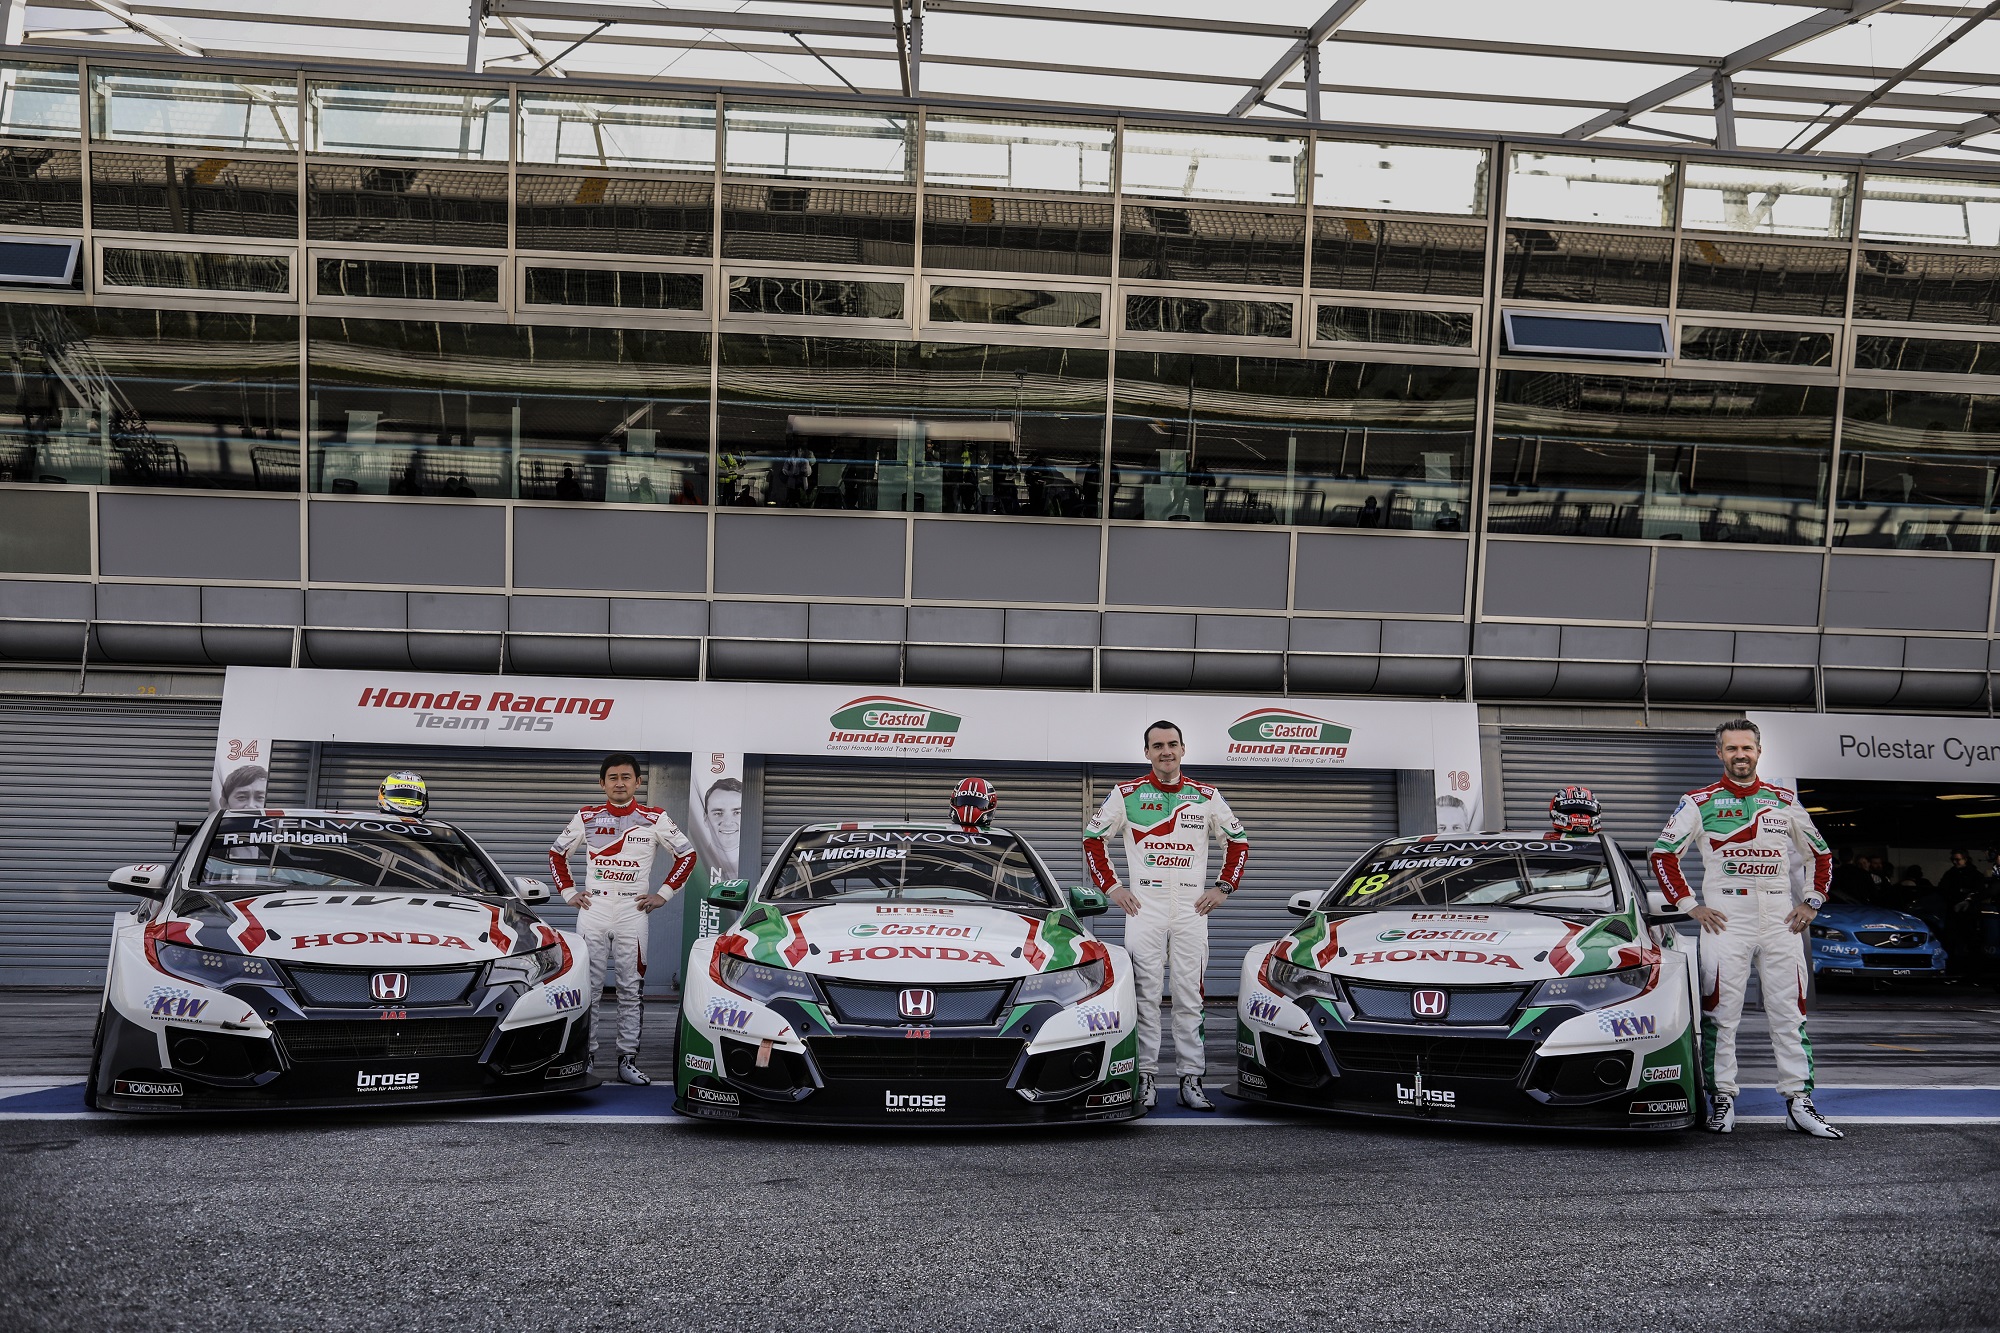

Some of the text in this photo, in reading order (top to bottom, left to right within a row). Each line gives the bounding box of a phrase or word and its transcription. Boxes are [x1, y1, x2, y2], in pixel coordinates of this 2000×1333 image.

[358, 688, 614, 720] Honda Racing
[413, 712, 553, 731] Team JAS
[879, 712, 926, 726] Castrol
[1275, 724, 1318, 738] Castrol
[829, 731, 956, 748] Honda Racing
[227, 739, 259, 761] 34
[1228, 743, 1348, 759] Honda Racing
[1839, 735, 1935, 760] Polestar
[711, 753, 726, 774] 5
[394, 784, 422, 792] HONDA
[1447, 771, 1471, 791] 18
[955, 790, 989, 801] HONDA
[1140, 803, 1163, 811] JAS
[1560, 799, 1597, 809] HONDA
[1181, 812, 1205, 821] brose
[1716, 809, 1743, 818] JAS
[1761, 816, 1787, 826] brose
[252, 818, 433, 836] KENWOOD
[595, 827, 616, 835] JAS
[223, 832, 348, 846] R. Michigami
[627, 835, 651, 843] brose
[826, 832, 992, 846] KENWOOD
[1144, 841, 1195, 851] HONDA
[798, 847, 907, 862] N. Michelisz
[1402, 841, 1574, 855] KENWOOD
[1722, 849, 1782, 858] HONDA
[595, 859, 640, 868] HONDA
[1156, 855, 1191, 867] Castrol
[1371, 856, 1474, 873] T. Monteiro
[1738, 862, 1779, 875] Castrol
[603, 869, 636, 882] Castrol
[669, 856, 692, 884] HONDA
[1345, 873, 1390, 897] 18
[1656, 859, 1679, 899] HONDA
[263, 895, 481, 913] CIVIC
[876, 906, 954, 915] brose
[699, 898, 708, 938] ORBERT
[1411, 913, 1490, 921] brose
[881, 923, 971, 938] Castrol
[1406, 929, 1500, 943] Castrol
[291, 932, 475, 950] HONDA
[827, 946, 1006, 967] HONDA
[1821, 945, 1859, 955] DENSO
[1350, 950, 1524, 970] HONDA
[152, 996, 209, 1018] KW
[554, 989, 582, 1010] KW
[380, 1011, 407, 1020] JAS
[710, 1006, 754, 1029] KW
[1249, 1000, 1281, 1022] KW
[1086, 1010, 1120, 1032] KW
[1611, 1015, 1656, 1038] KW
[905, 1029, 931, 1039] JAS
[690, 1056, 712, 1071] Castrol
[1116, 1059, 1134, 1073] Castrol
[357, 1070, 420, 1087] brose
[1653, 1067, 1679, 1080] Castrol
[128, 1083, 180, 1094] YOKOHAMA
[698, 1088, 738, 1103] YOKOHAMA
[885, 1090, 946, 1107] brose
[1102, 1089, 1132, 1104] YOKOHAMA
[1647, 1101, 1687, 1112] YOKOHAMA
